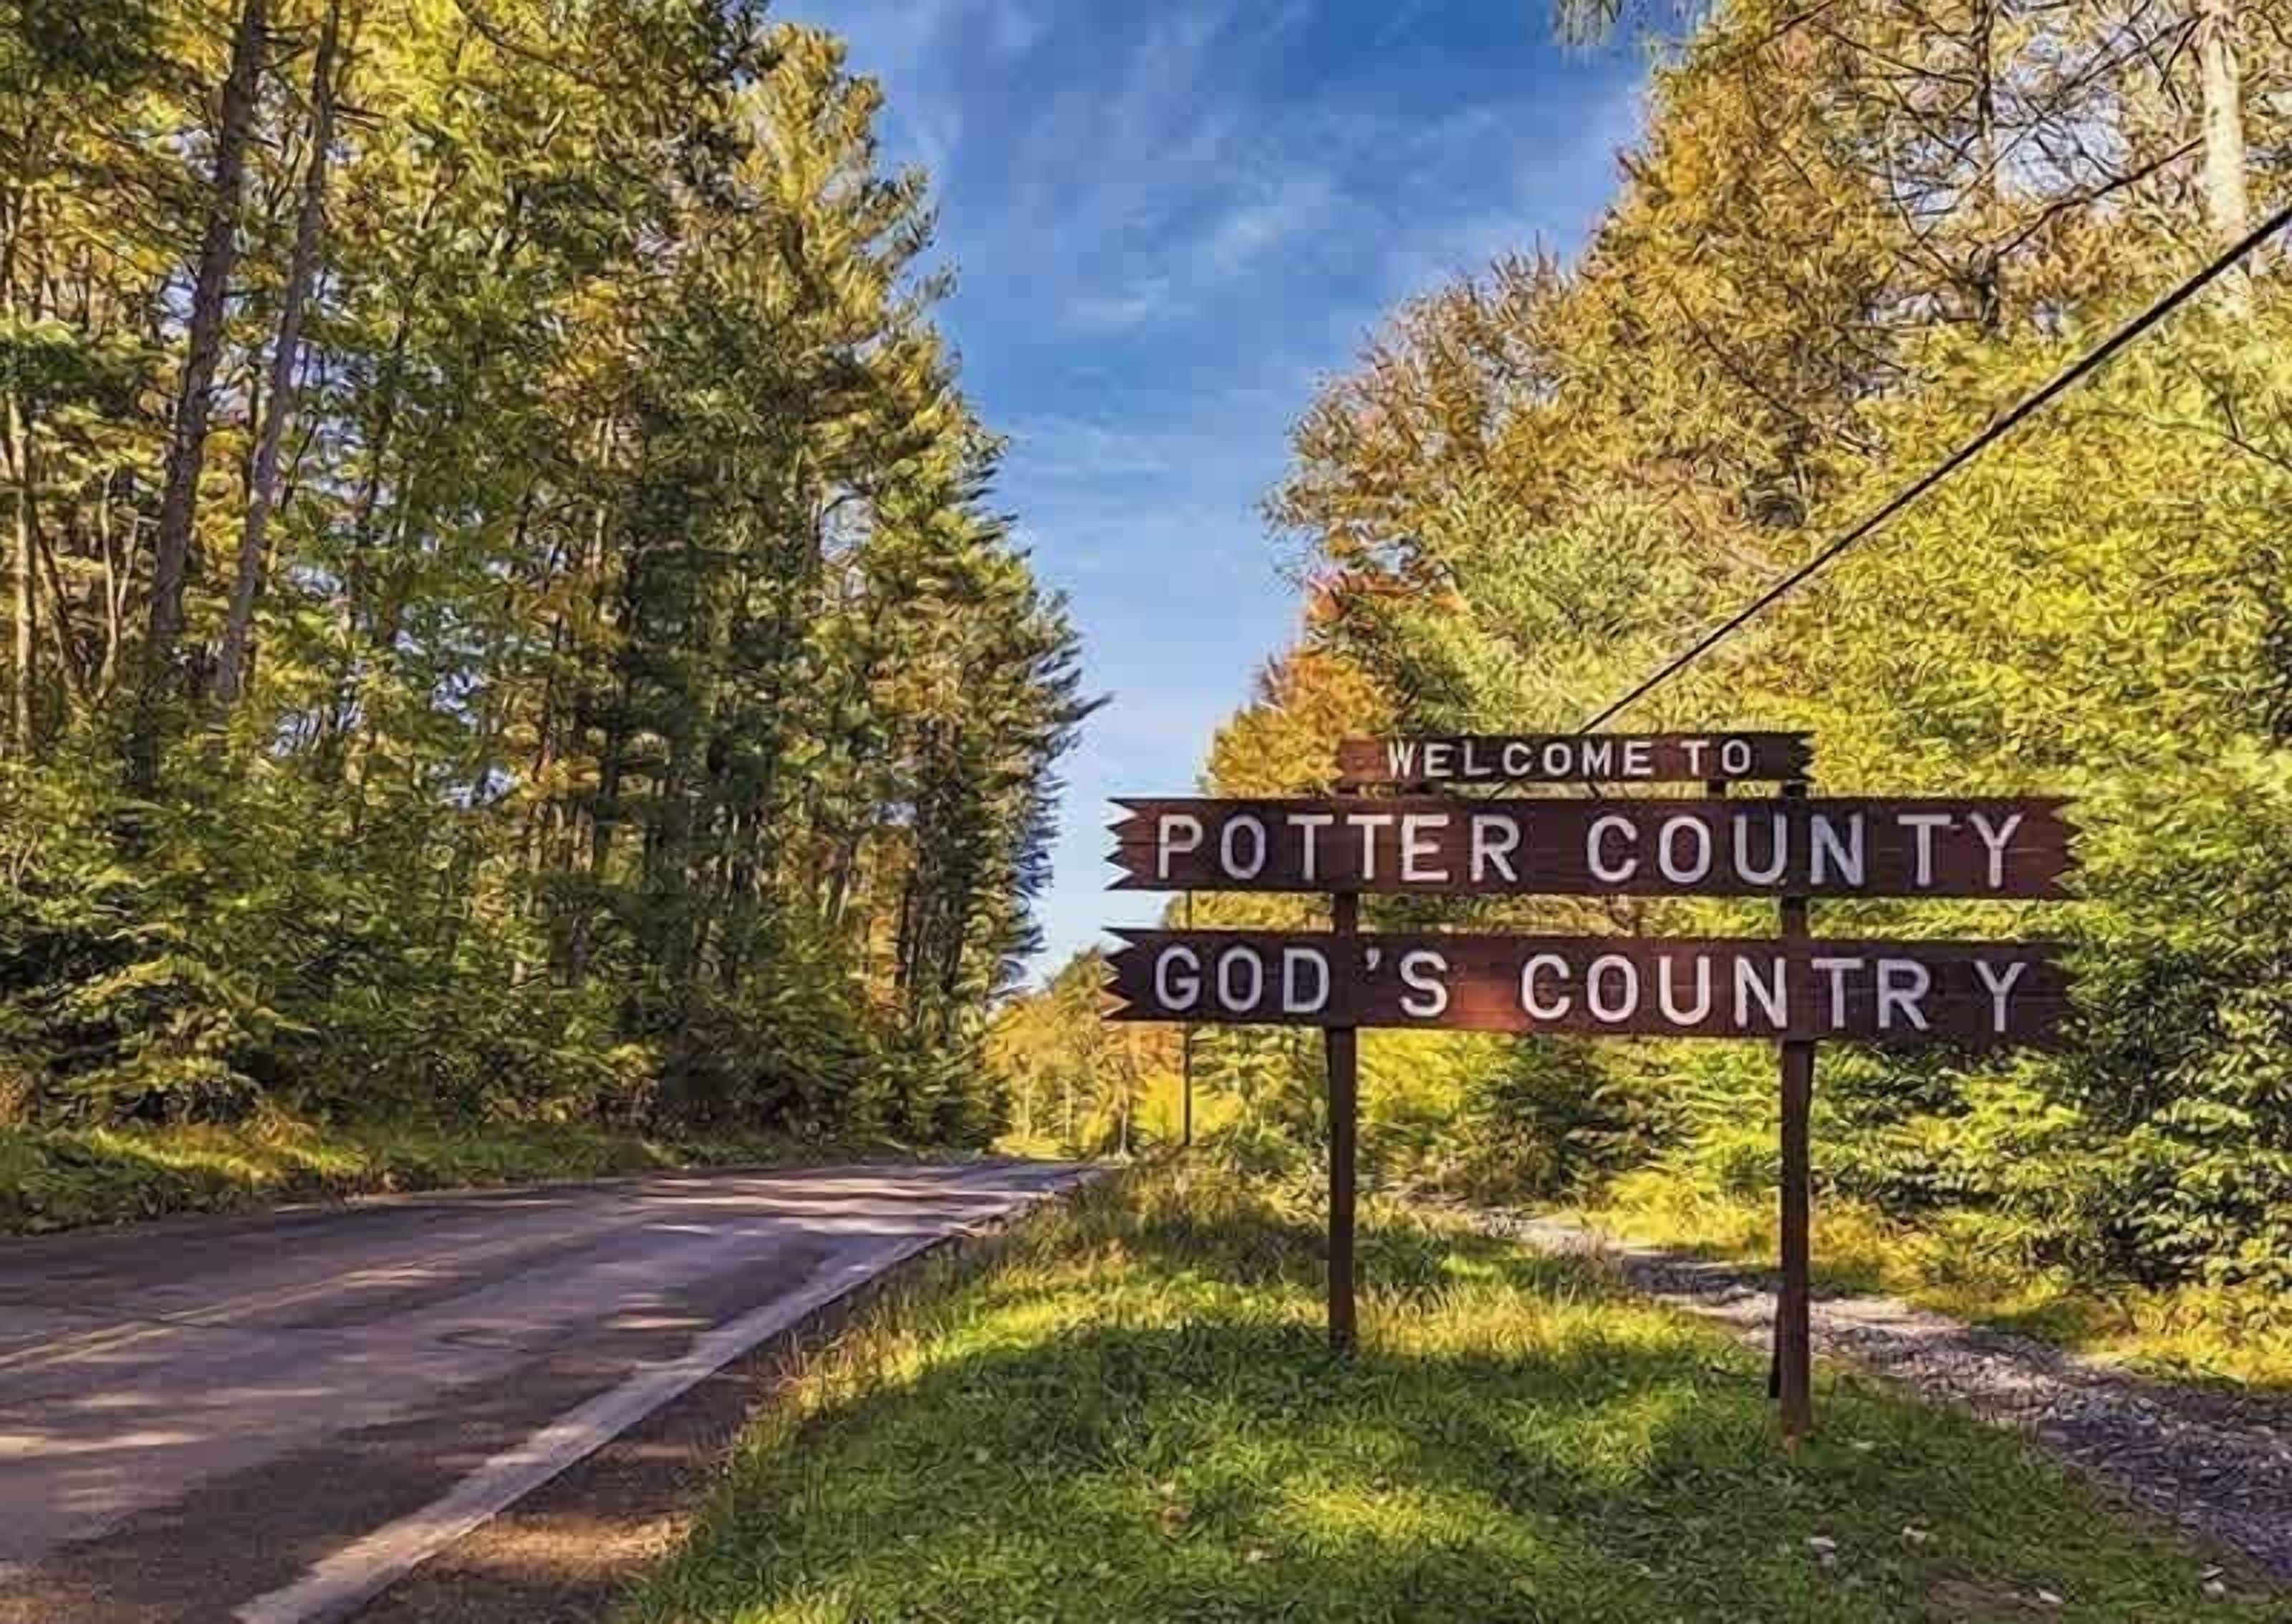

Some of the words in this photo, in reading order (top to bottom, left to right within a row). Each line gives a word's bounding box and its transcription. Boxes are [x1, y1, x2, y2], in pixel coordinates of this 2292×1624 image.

[1386, 739, 1652, 778] WELCOME
[1680, 739, 1752, 775] TO
[1157, 814, 1519, 882] POTTER
[1586, 814, 2022, 887] COUNTY
[1522, 954, 2027, 1031] COUNTRY
